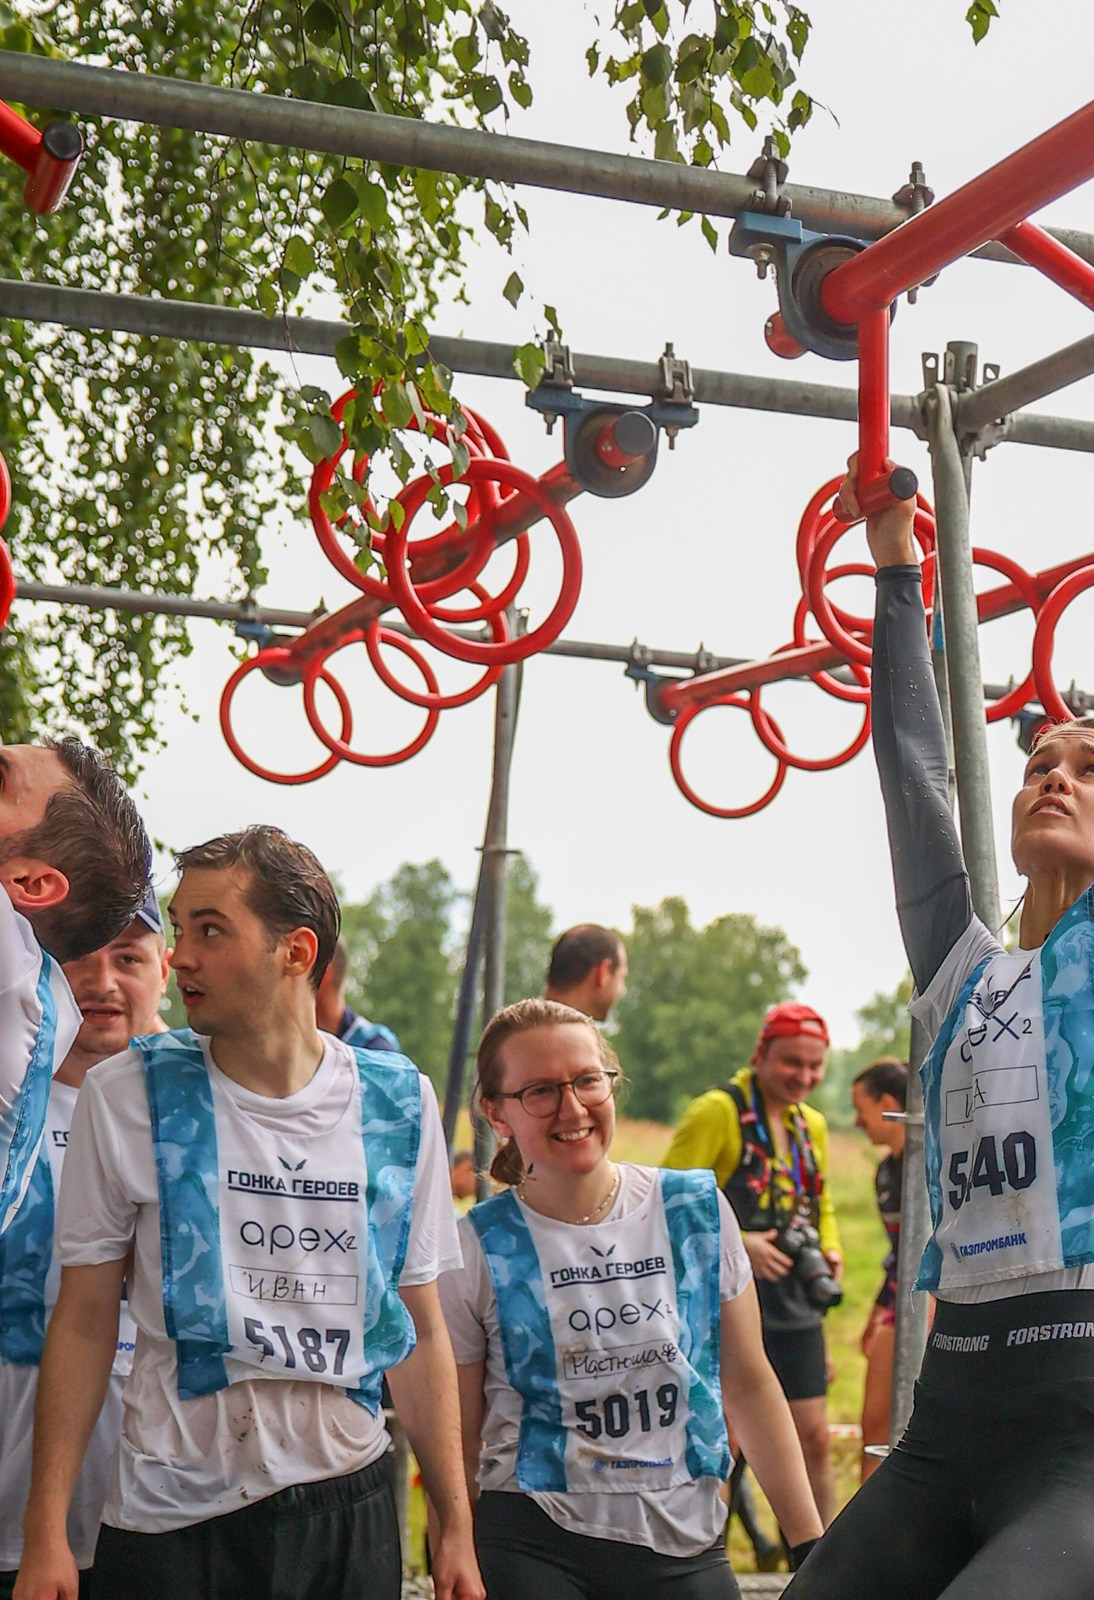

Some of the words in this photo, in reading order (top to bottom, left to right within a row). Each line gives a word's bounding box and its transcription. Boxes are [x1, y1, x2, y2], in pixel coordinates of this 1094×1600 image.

[228, 1170, 287, 1192] ГОНКА
[292, 1179, 359, 1196] ГЕРОЕВ
[240, 1221, 347, 1254] apex
[960, 1231, 1027, 1258] ГАЗПРОМБАНК
[550, 1264, 601, 1284] ГОНКА
[606, 1256, 666, 1278] ГЕРОЕВ
[246, 1272, 326, 1300] ИВАН
[568, 1298, 666, 1335] apex
[243, 1316, 350, 1375] 5187
[932, 1332, 990, 1353] FORSTRONG
[575, 1383, 679, 1439] 5019
